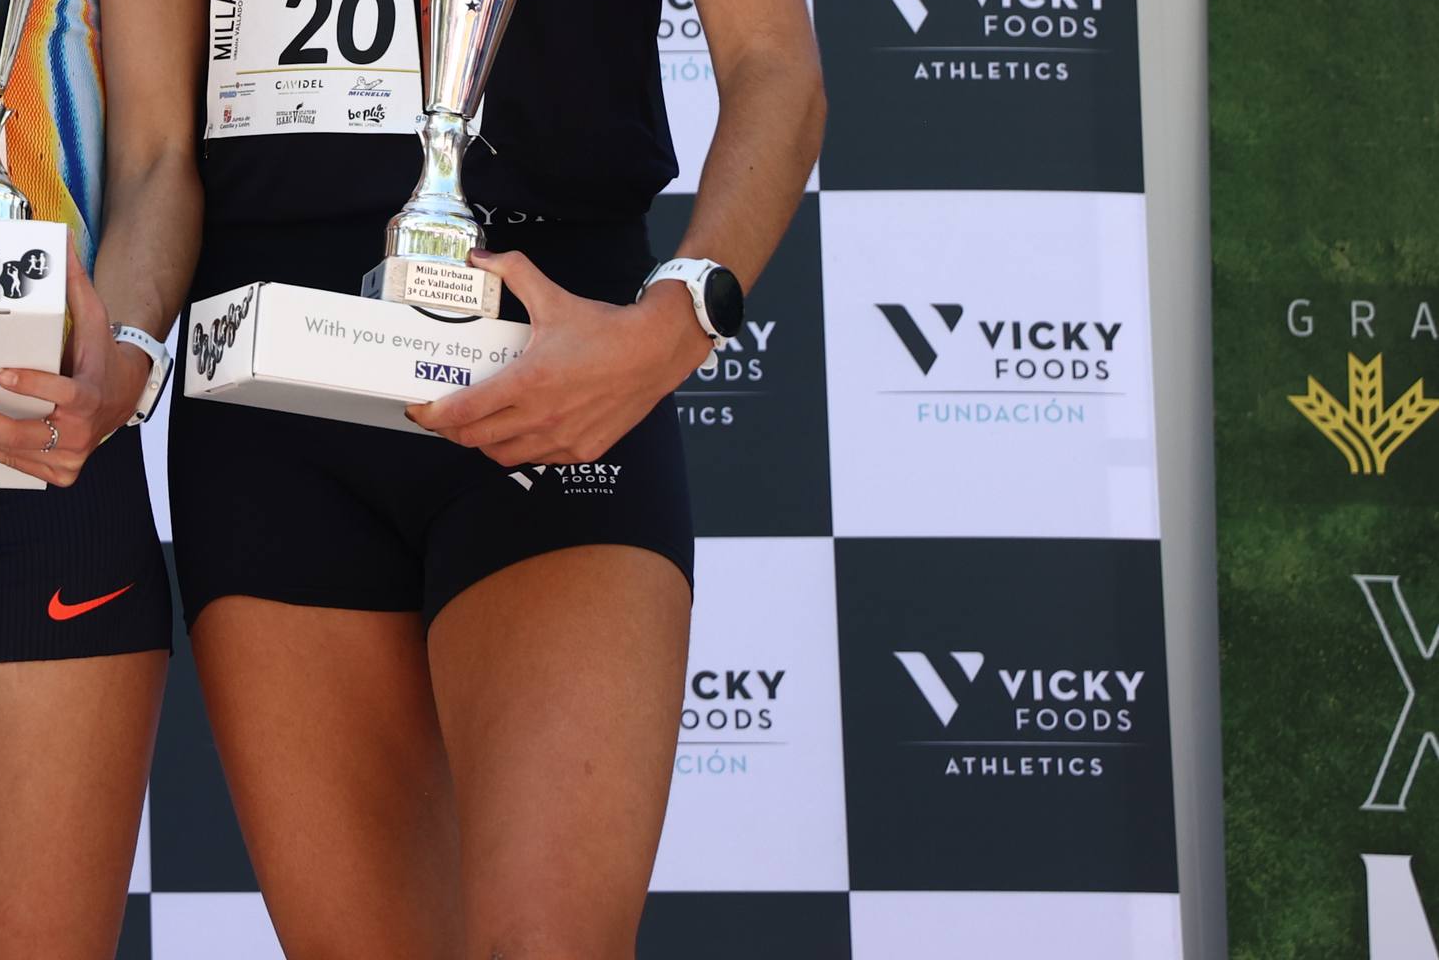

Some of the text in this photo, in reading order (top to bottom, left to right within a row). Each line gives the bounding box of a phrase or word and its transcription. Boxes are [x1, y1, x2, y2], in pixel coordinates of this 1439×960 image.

[985, 15, 1097, 38] FOODS
[915, 62, 1068, 80] ATHLETICS
[275, 79, 324, 90] CAVIDEL
[276, 116, 293, 126] ISAAC
[348, 106, 385, 122] be plus
[416, 265, 473, 281] Milla Urbana
[414, 277, 473, 292] de Valladolid
[419, 289, 478, 305] CLASIFICADA
[304, 315, 346, 338] With
[352, 328, 385, 345] you
[392, 335, 441, 356] every
[446, 342, 482, 363] step
[489, 347, 509, 364] of
[979, 322, 1121, 351] VICKY
[416, 361, 470, 385] START
[996, 359, 1109, 380] FOODS
[917, 398, 1085, 424] FUNDACIÓN
[554, 464, 621, 476] VICKY
[562, 475, 616, 484] FOODS
[691, 670, 786, 700] CKY
[999, 670, 1144, 701] VICKY
[680, 708, 772, 730] OODS
[1016, 709, 1131, 731] FOODS
[946, 757, 1102, 775] ATHLETICS
